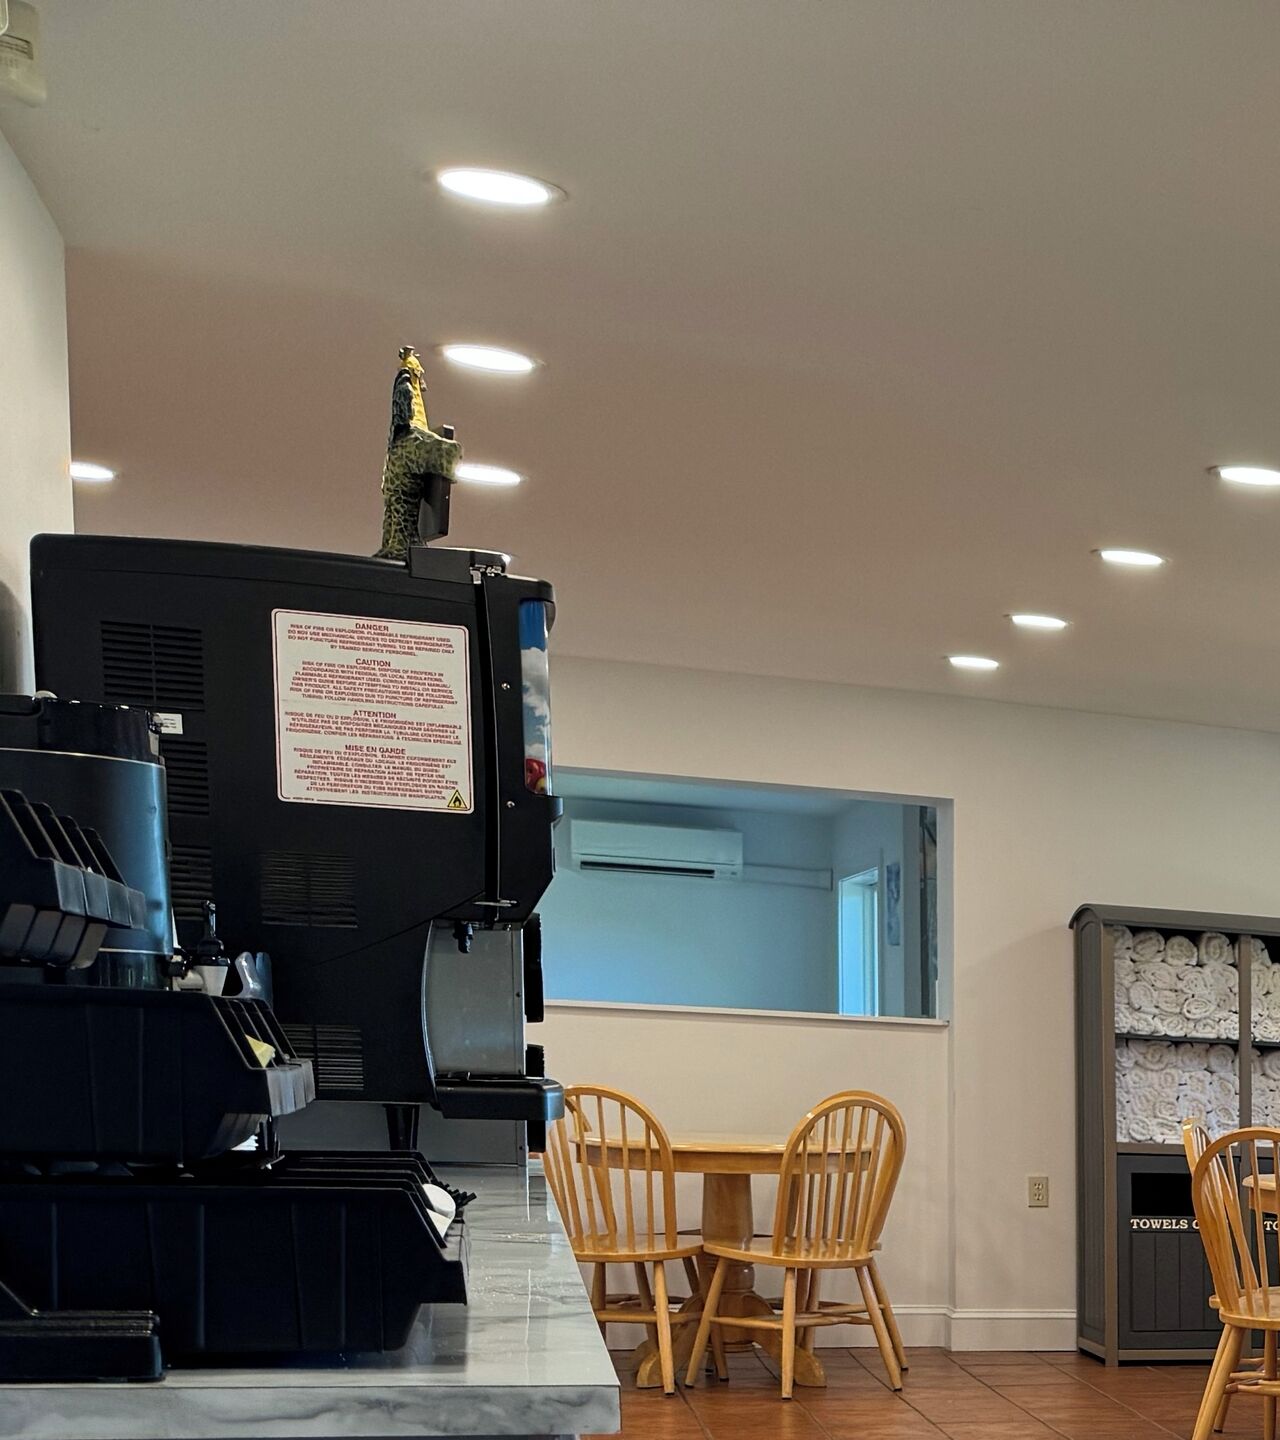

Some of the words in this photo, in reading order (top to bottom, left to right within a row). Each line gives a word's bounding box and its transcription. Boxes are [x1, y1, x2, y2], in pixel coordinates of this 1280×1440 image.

[355, 623, 389, 632] DANGER
[355, 658, 391, 668] CAUTION
[353, 709, 397, 719] ATTENTION
[1131, 1219, 1188, 1229] TOWELS
